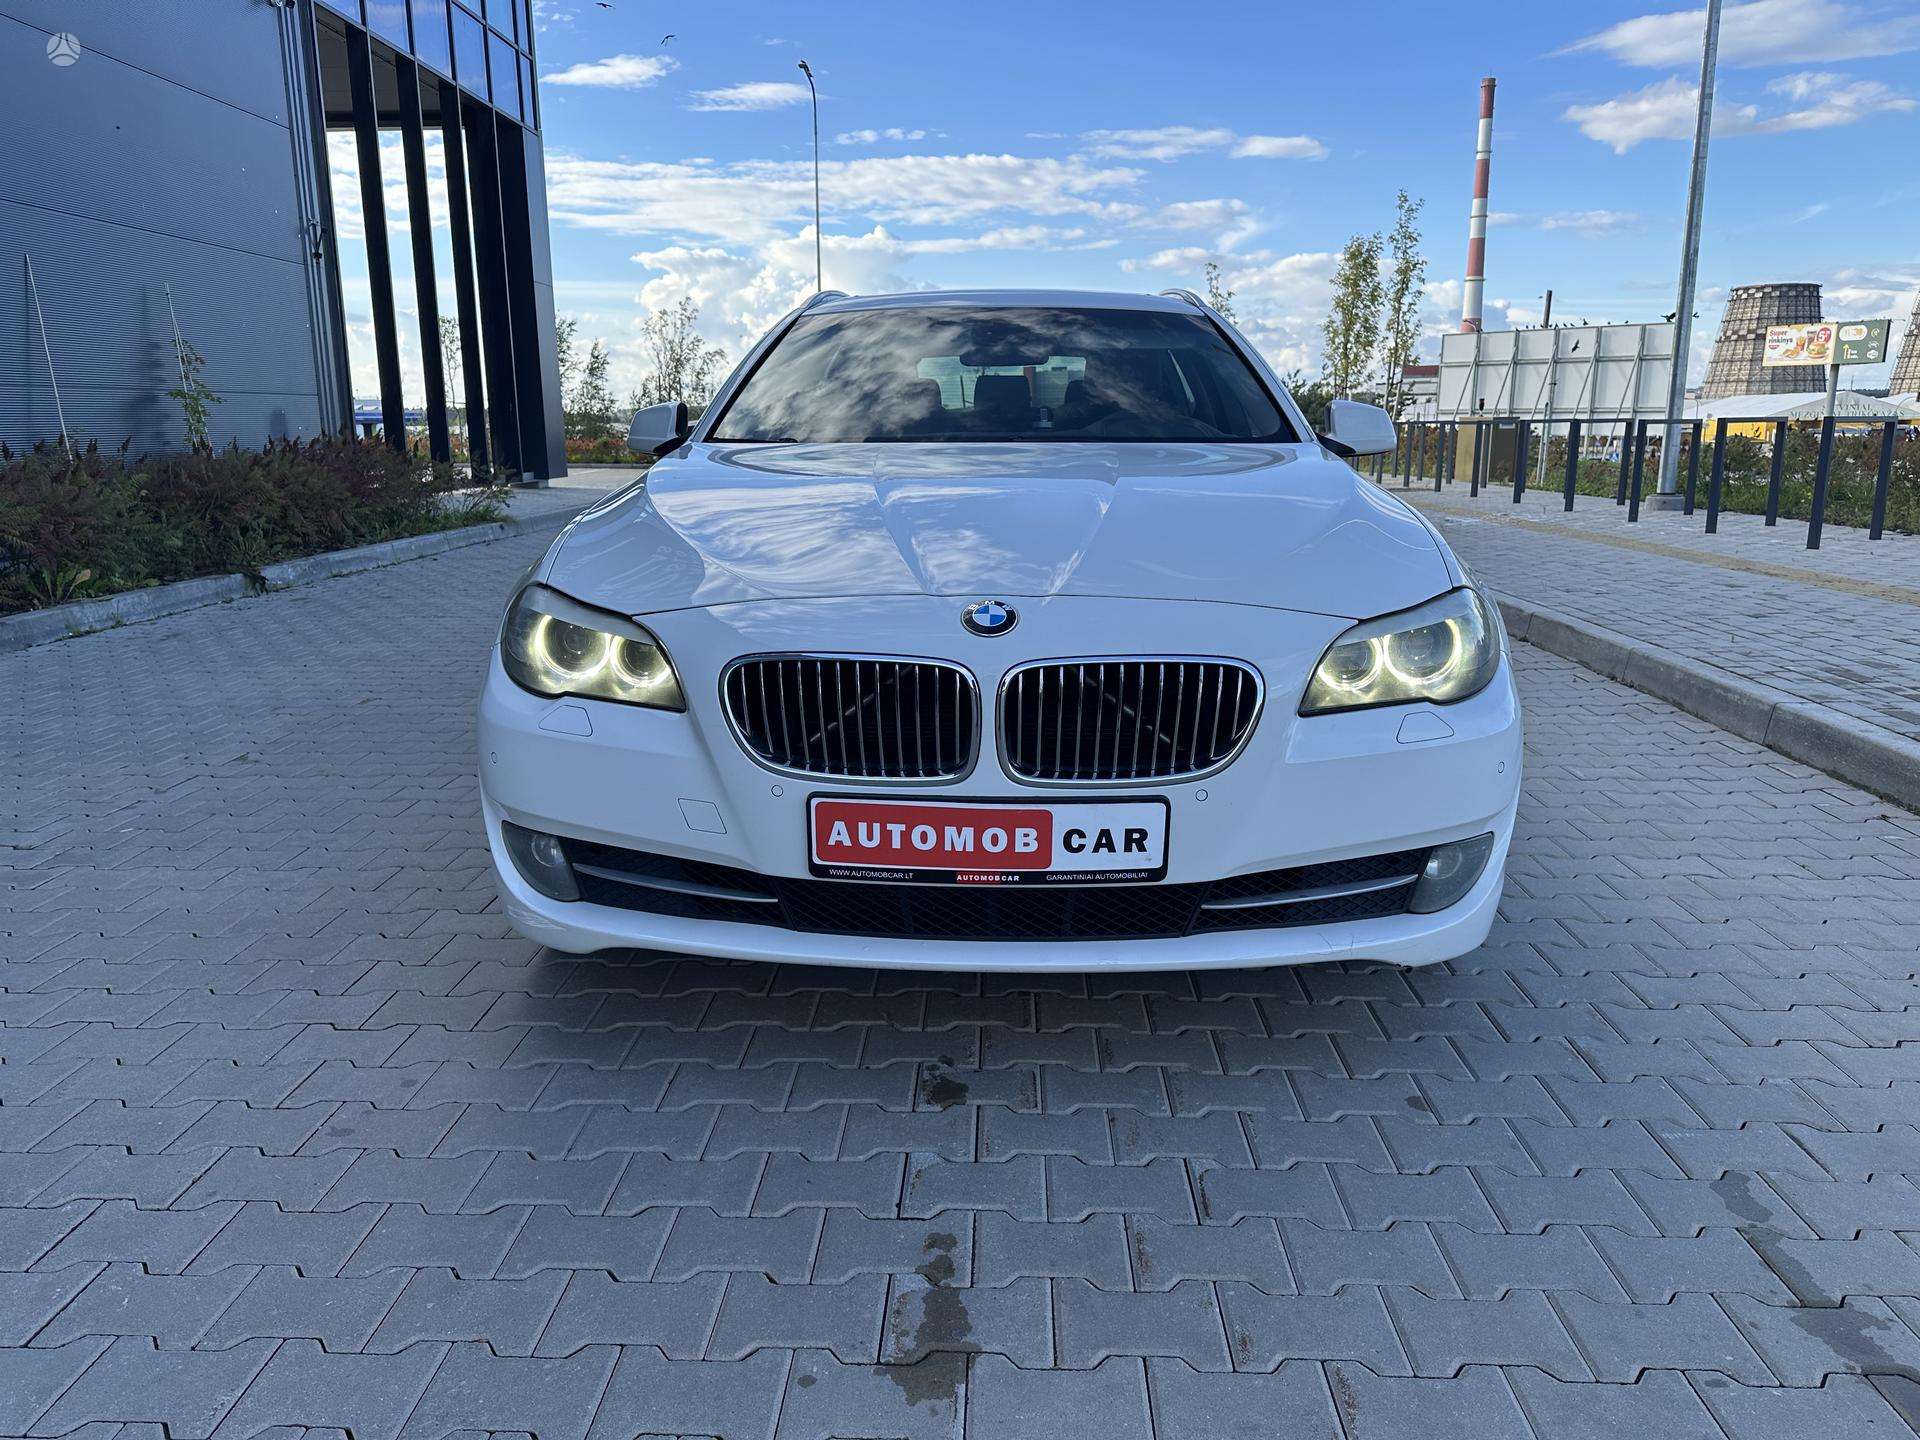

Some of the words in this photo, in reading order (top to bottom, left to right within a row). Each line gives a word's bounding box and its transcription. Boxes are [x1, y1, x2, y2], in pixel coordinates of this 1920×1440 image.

[1768, 336, 1793, 345] rinkinys
[827, 820, 1039, 853] AUTOMOB
[1062, 828, 1149, 854] CAR
[1046, 873, 1094, 881] GARANTINIAI
[1095, 872, 1148, 880] AUTOMOBILIAI
